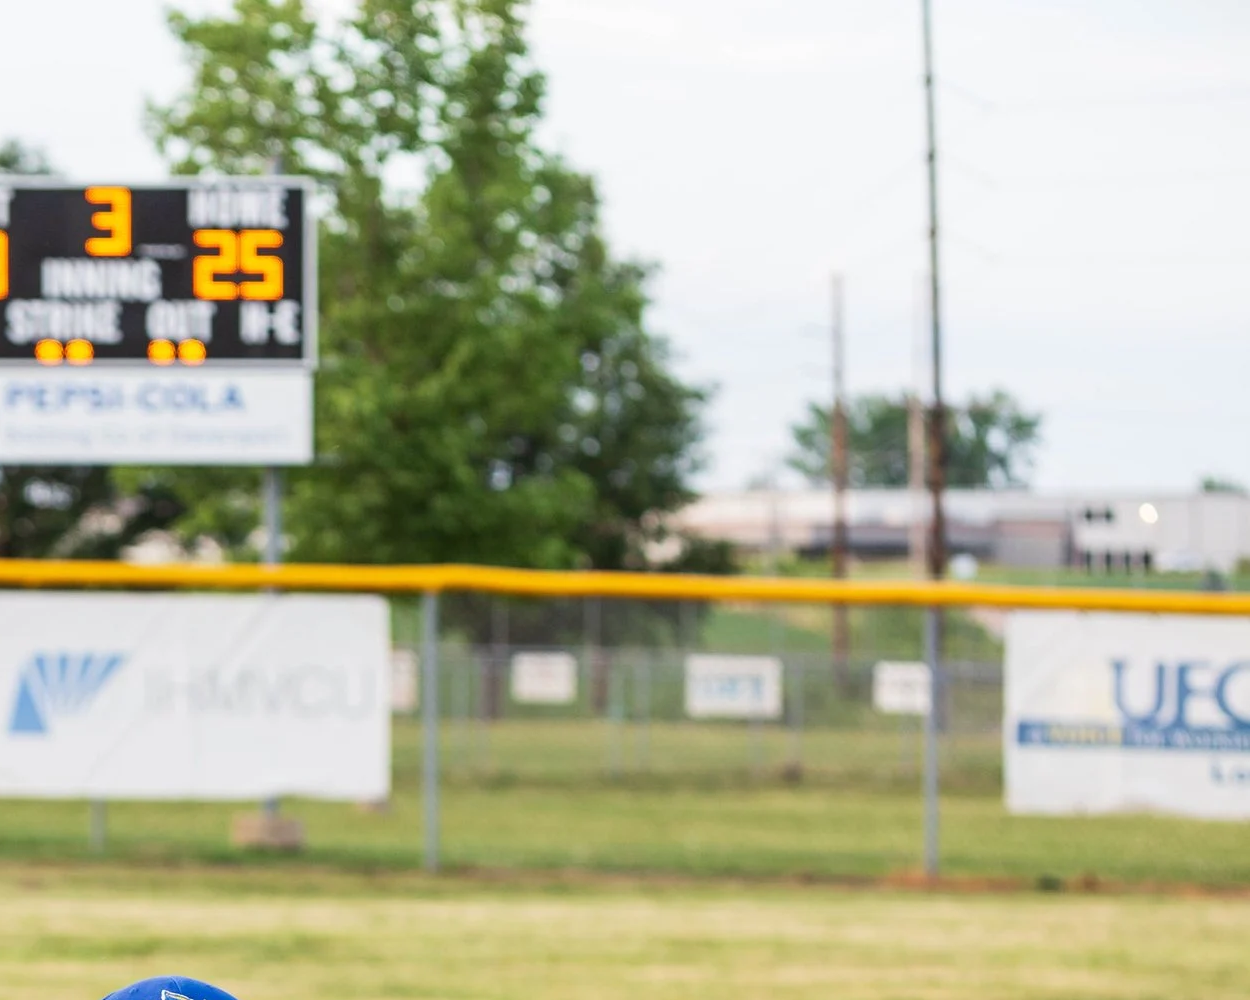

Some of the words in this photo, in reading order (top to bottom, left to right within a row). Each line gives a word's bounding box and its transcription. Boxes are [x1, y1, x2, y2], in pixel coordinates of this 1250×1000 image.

[84, 185, 133, 257] 3
[187, 185, 289, 228] HOME
[41, 257, 163, 299] INNING
[193, 228, 284, 300] 25
[5, 301, 123, 344] STRIKE
[146, 301, 218, 344] OUT
